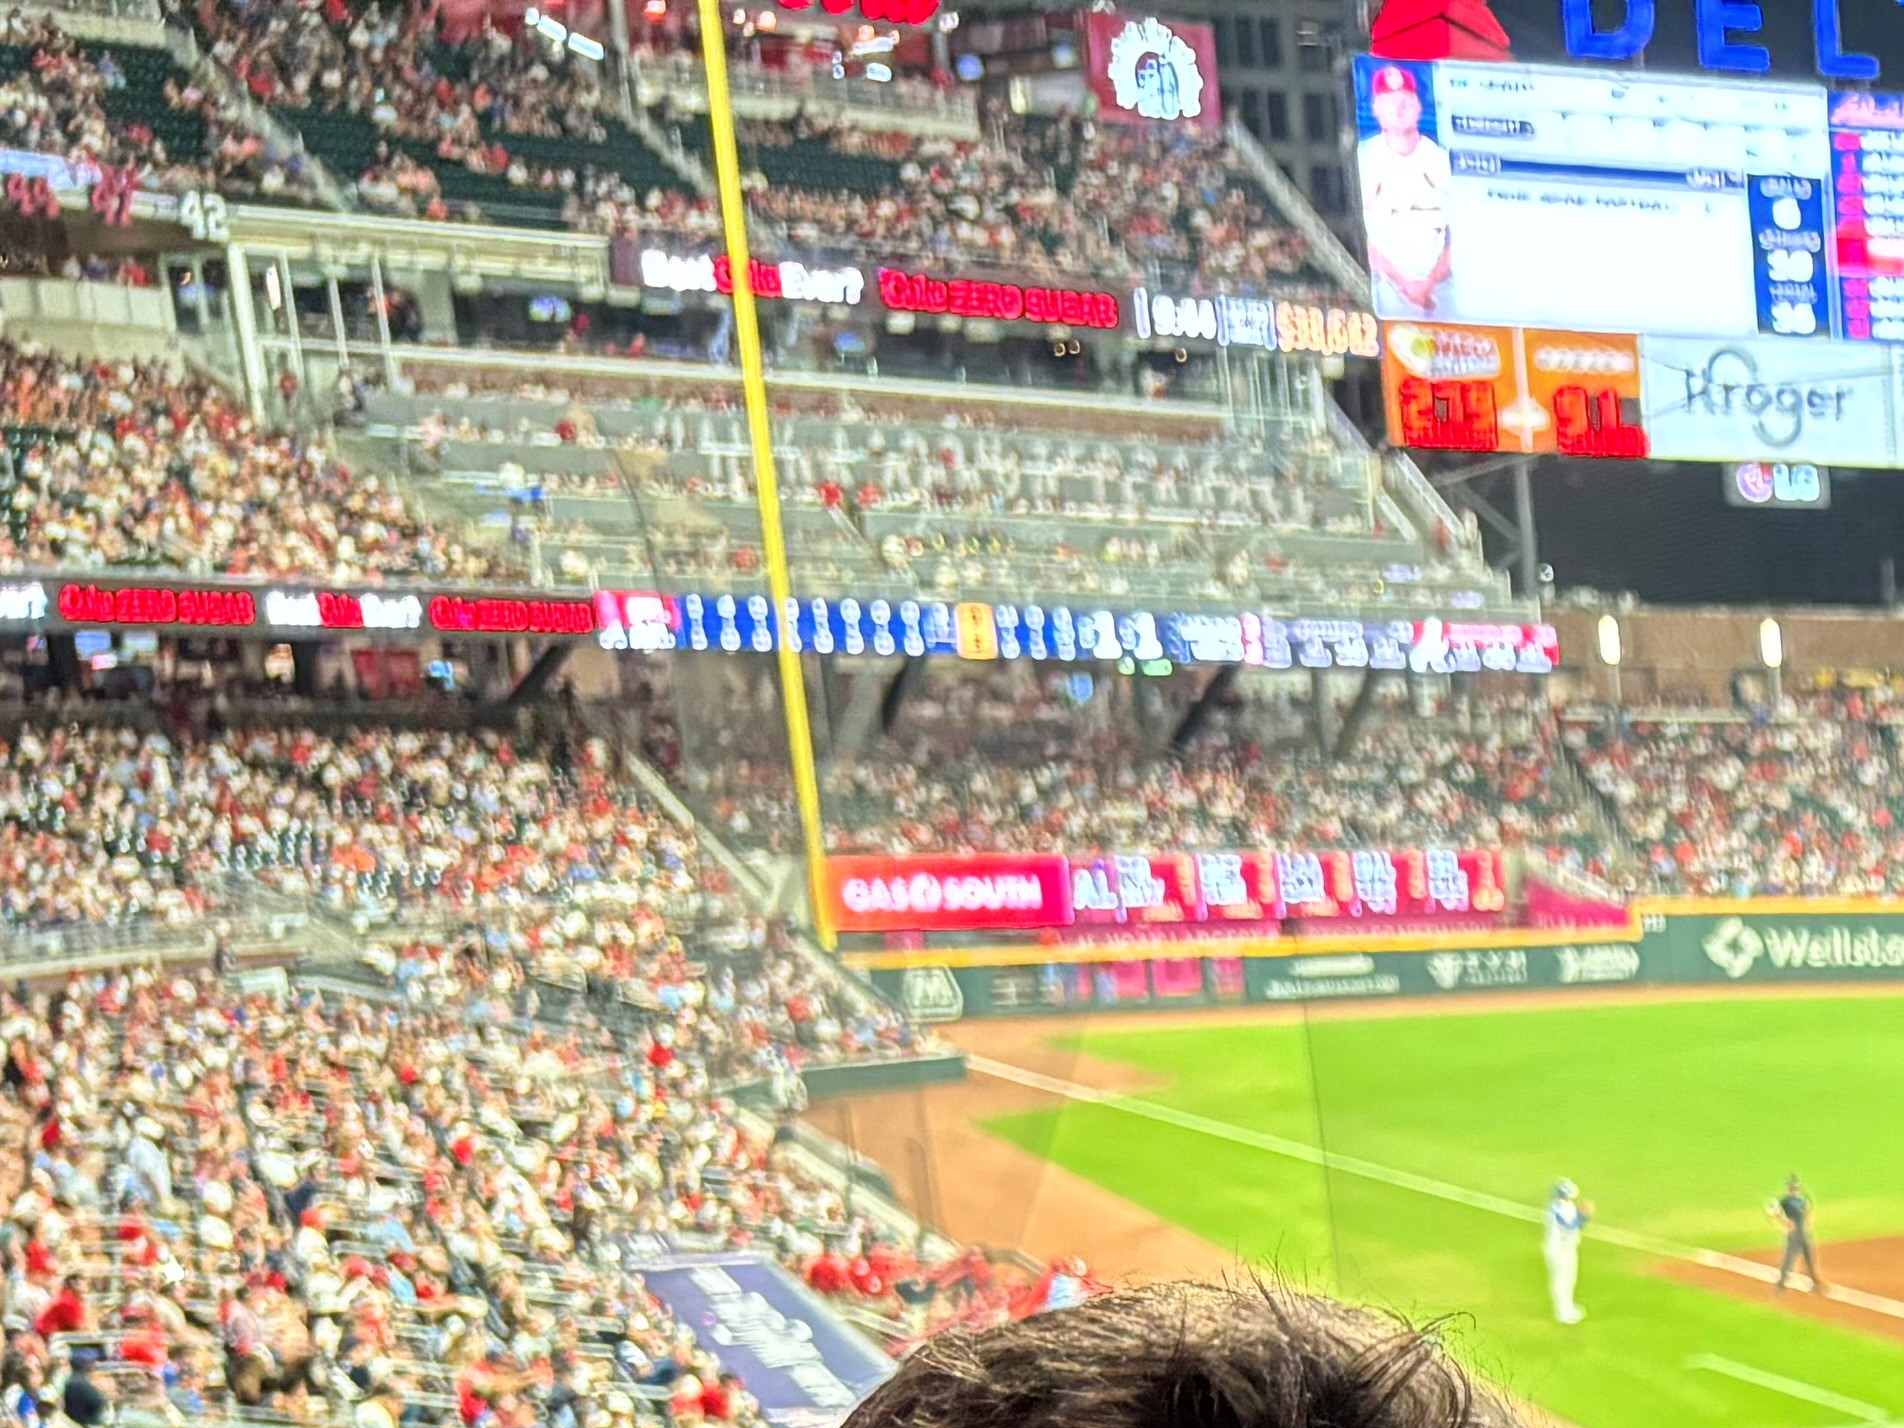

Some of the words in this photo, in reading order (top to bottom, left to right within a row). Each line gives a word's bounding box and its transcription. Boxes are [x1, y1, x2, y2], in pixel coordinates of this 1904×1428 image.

[180, 190, 230, 243] 42
[1684, 346, 1855, 448] Kroger
[843, 875, 911, 912] GAS
[943, 873, 1043, 911] SOUTH
